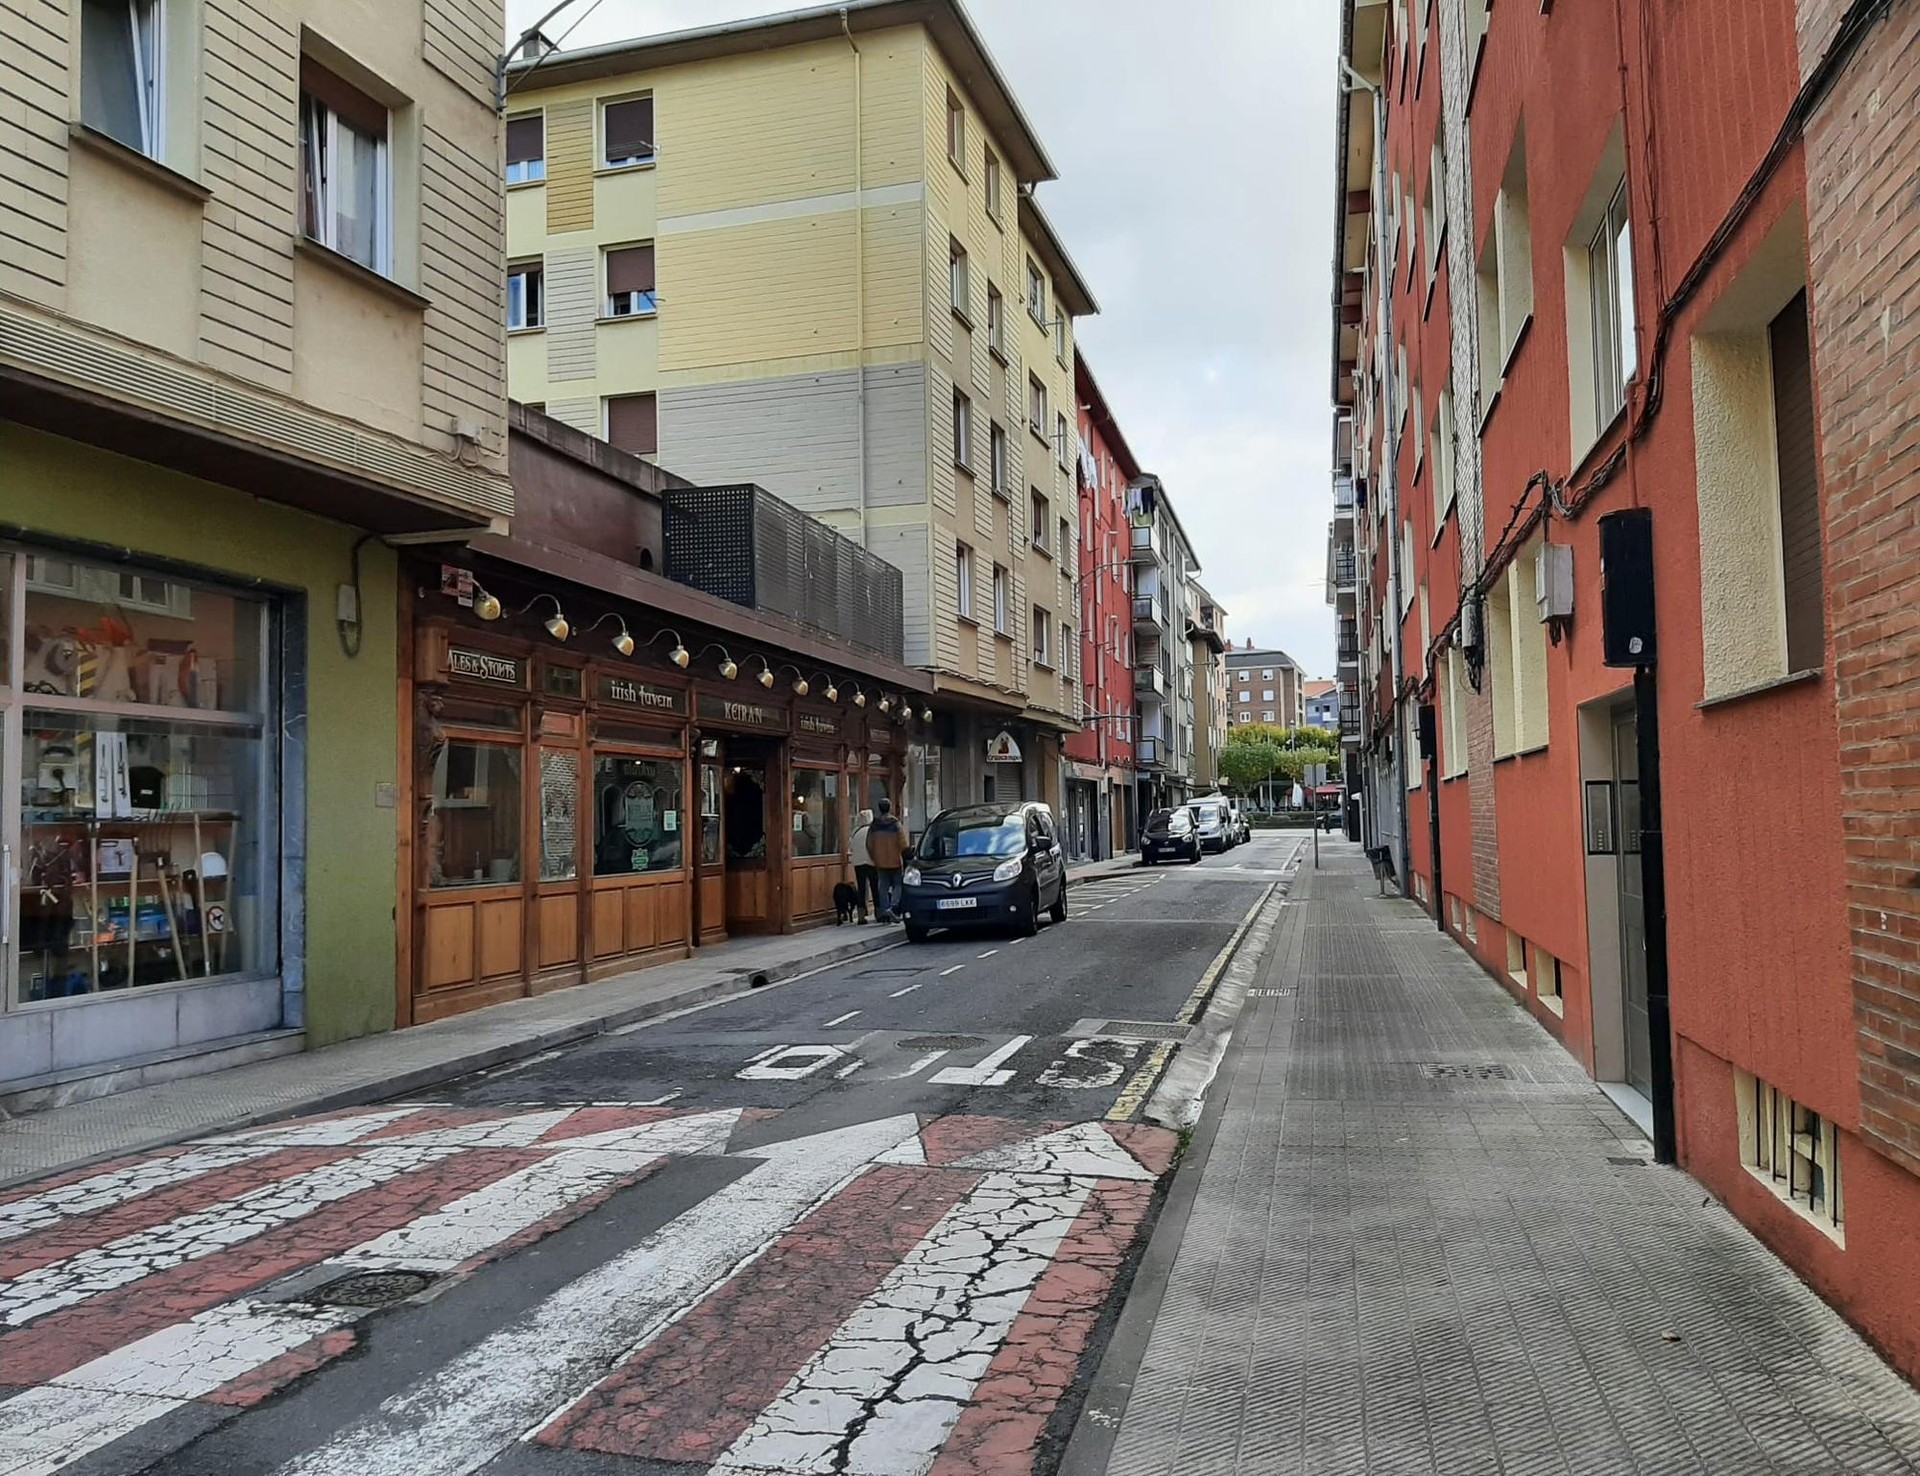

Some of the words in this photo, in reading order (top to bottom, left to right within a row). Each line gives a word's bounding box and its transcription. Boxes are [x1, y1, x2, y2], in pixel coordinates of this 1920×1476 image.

[471, 658, 479, 673] &
[611, 680, 637, 702] irish
[638, 685, 674, 709] tavern
[724, 702, 763, 724] KEIRAN
